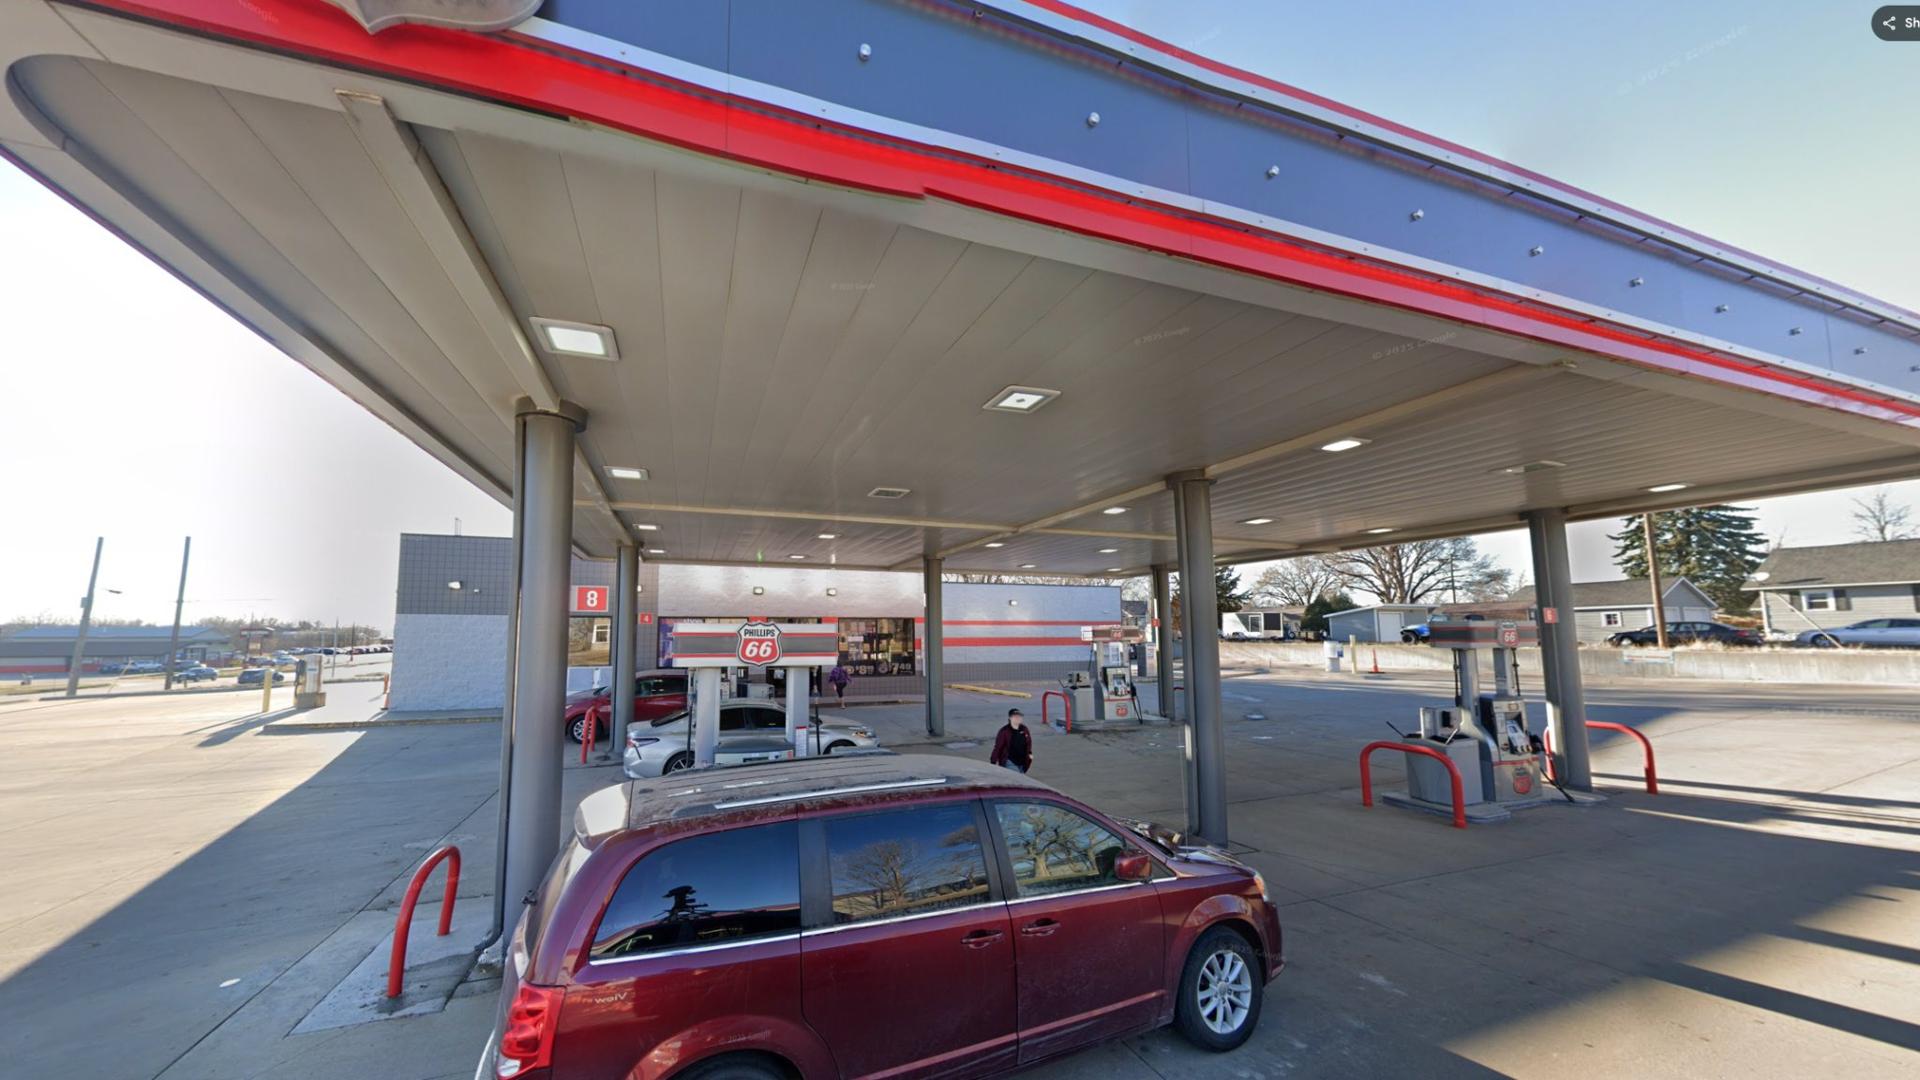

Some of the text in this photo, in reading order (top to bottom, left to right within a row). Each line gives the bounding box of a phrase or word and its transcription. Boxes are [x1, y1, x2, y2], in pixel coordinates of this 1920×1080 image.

[586, 590, 598, 608] 8
[744, 628, 776, 638] PHILLIPS
[1504, 631, 1516, 642] 66
[745, 641, 773, 658] 66
